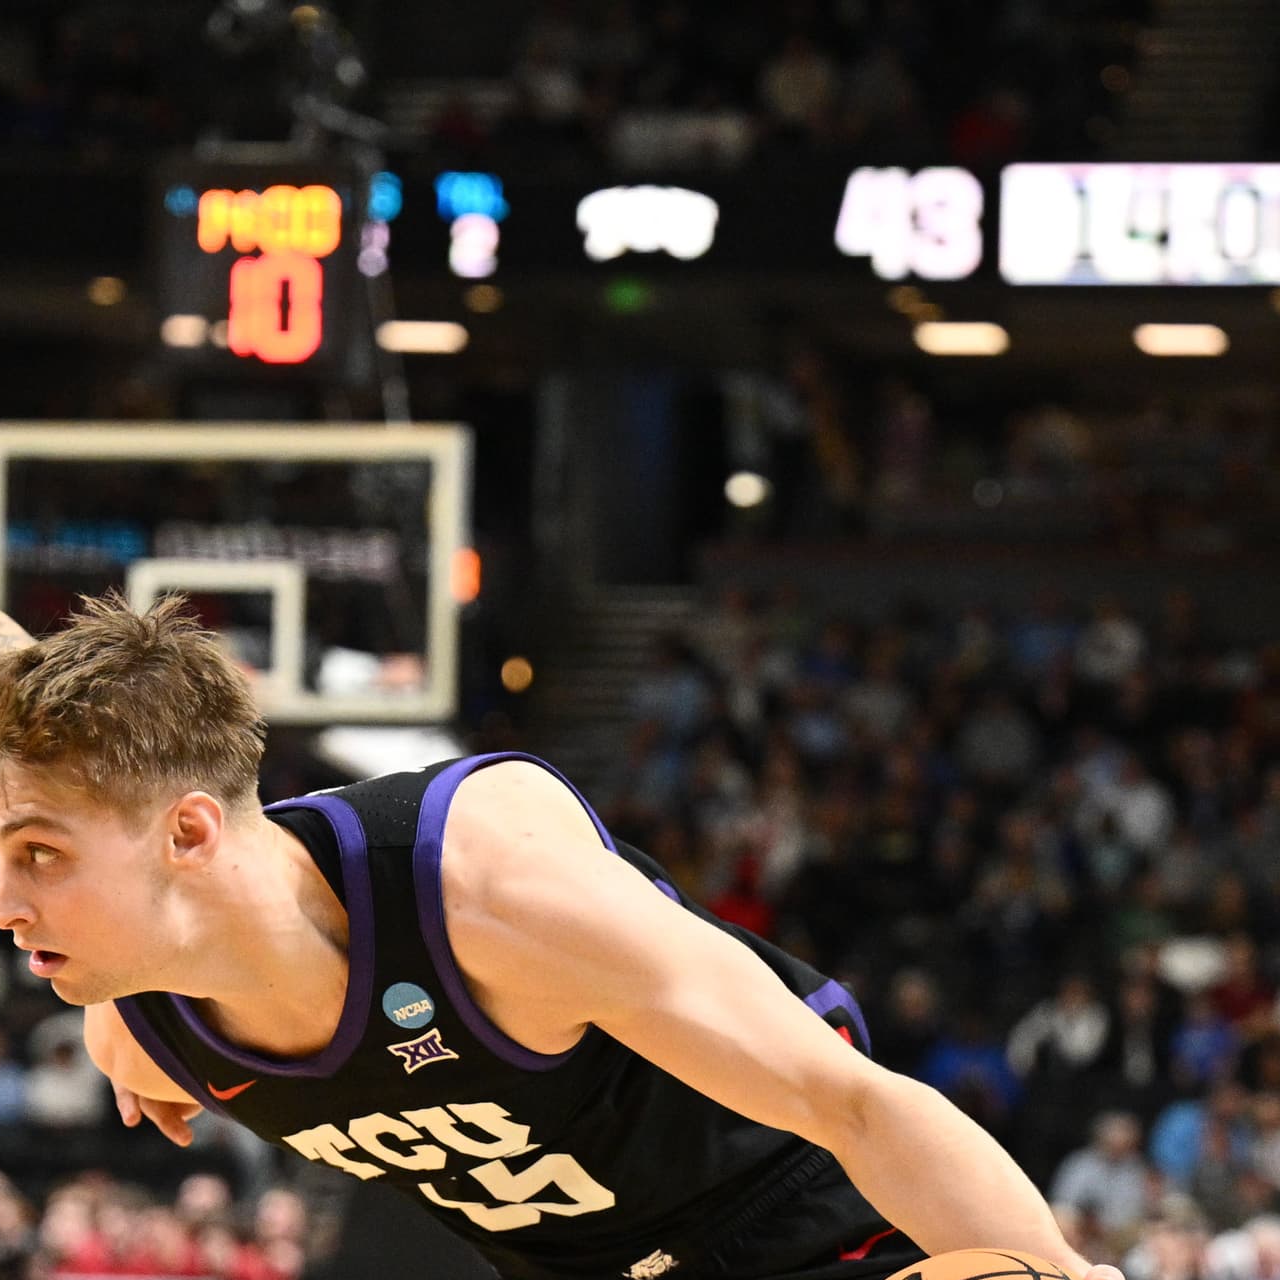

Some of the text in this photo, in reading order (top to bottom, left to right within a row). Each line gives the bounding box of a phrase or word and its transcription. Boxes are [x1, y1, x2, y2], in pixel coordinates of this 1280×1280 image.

[834, 165, 984, 281] 43
[393, 999, 433, 1022] NCAA
[281, 1101, 533, 1180] TCU
